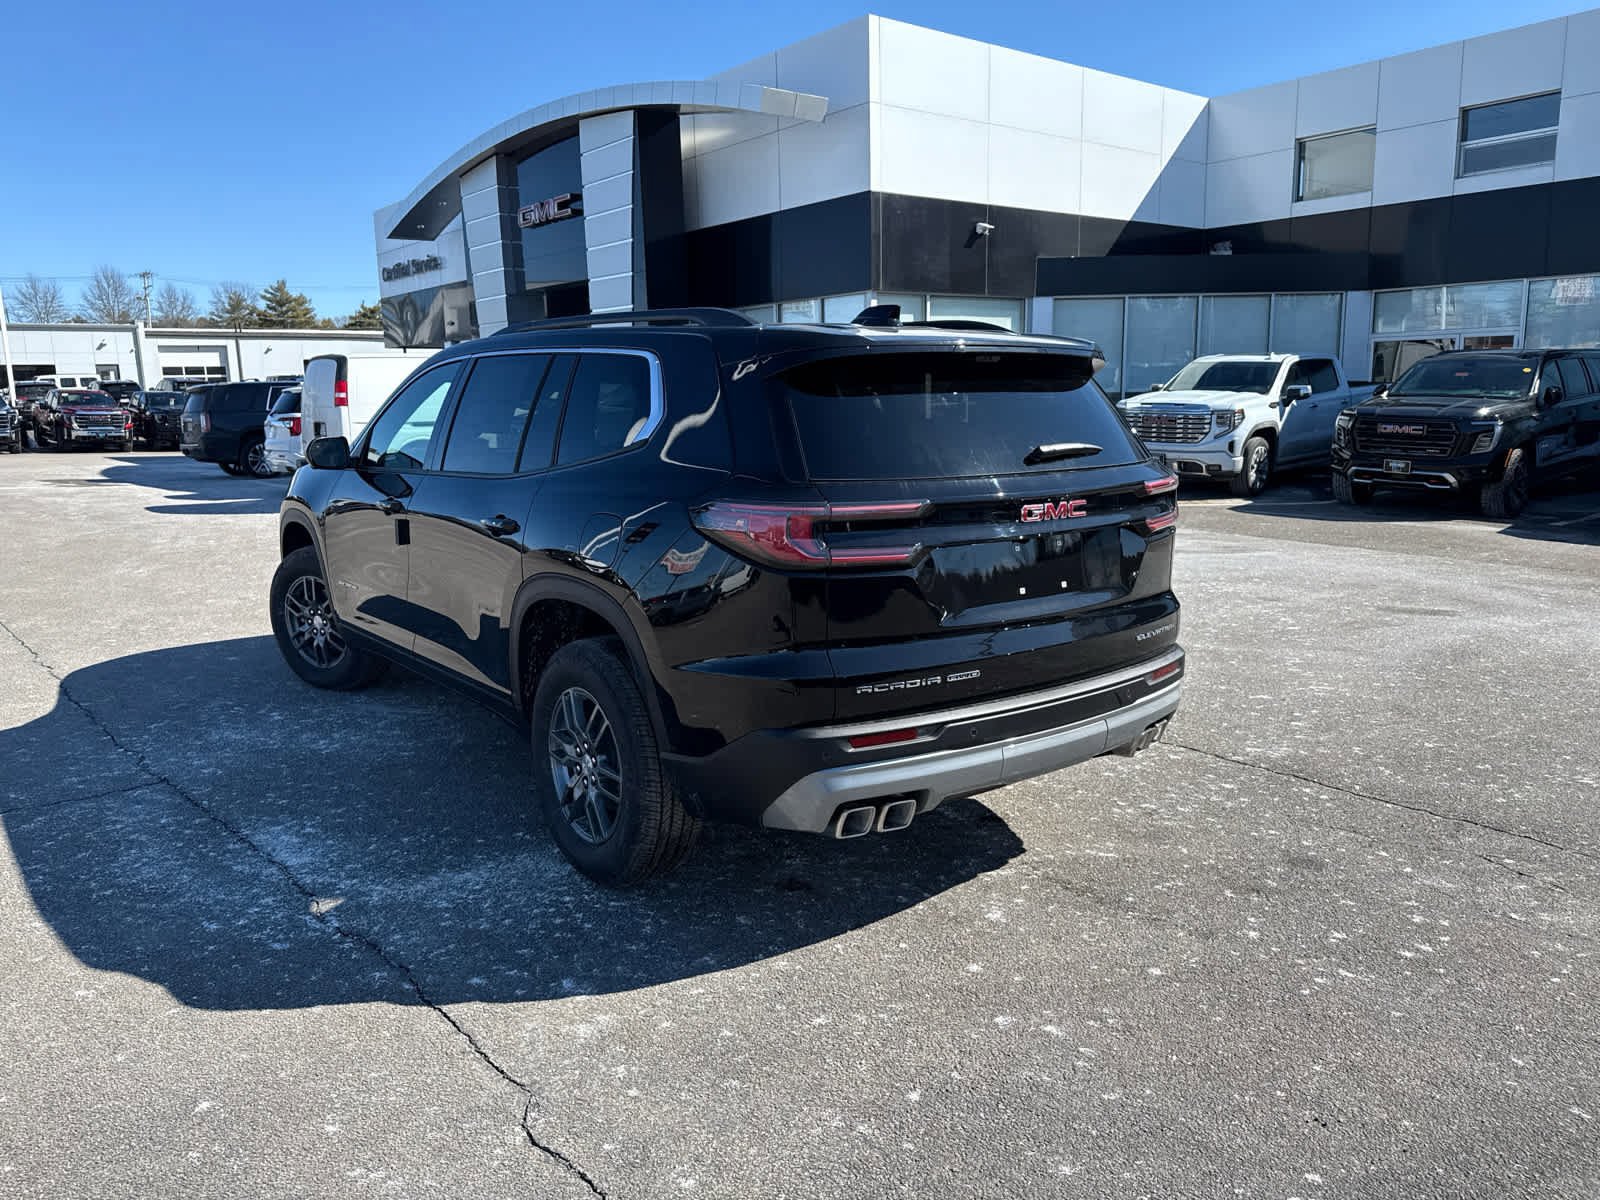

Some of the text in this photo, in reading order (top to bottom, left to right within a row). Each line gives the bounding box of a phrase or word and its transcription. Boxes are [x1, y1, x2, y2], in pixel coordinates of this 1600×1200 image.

[518, 193, 572, 228] GMC
[382, 254, 443, 281] Certified Service
[1379, 424, 1424, 434] GMC
[1020, 499, 1088, 522] GMC
[856, 676, 941, 694] ACADIA
